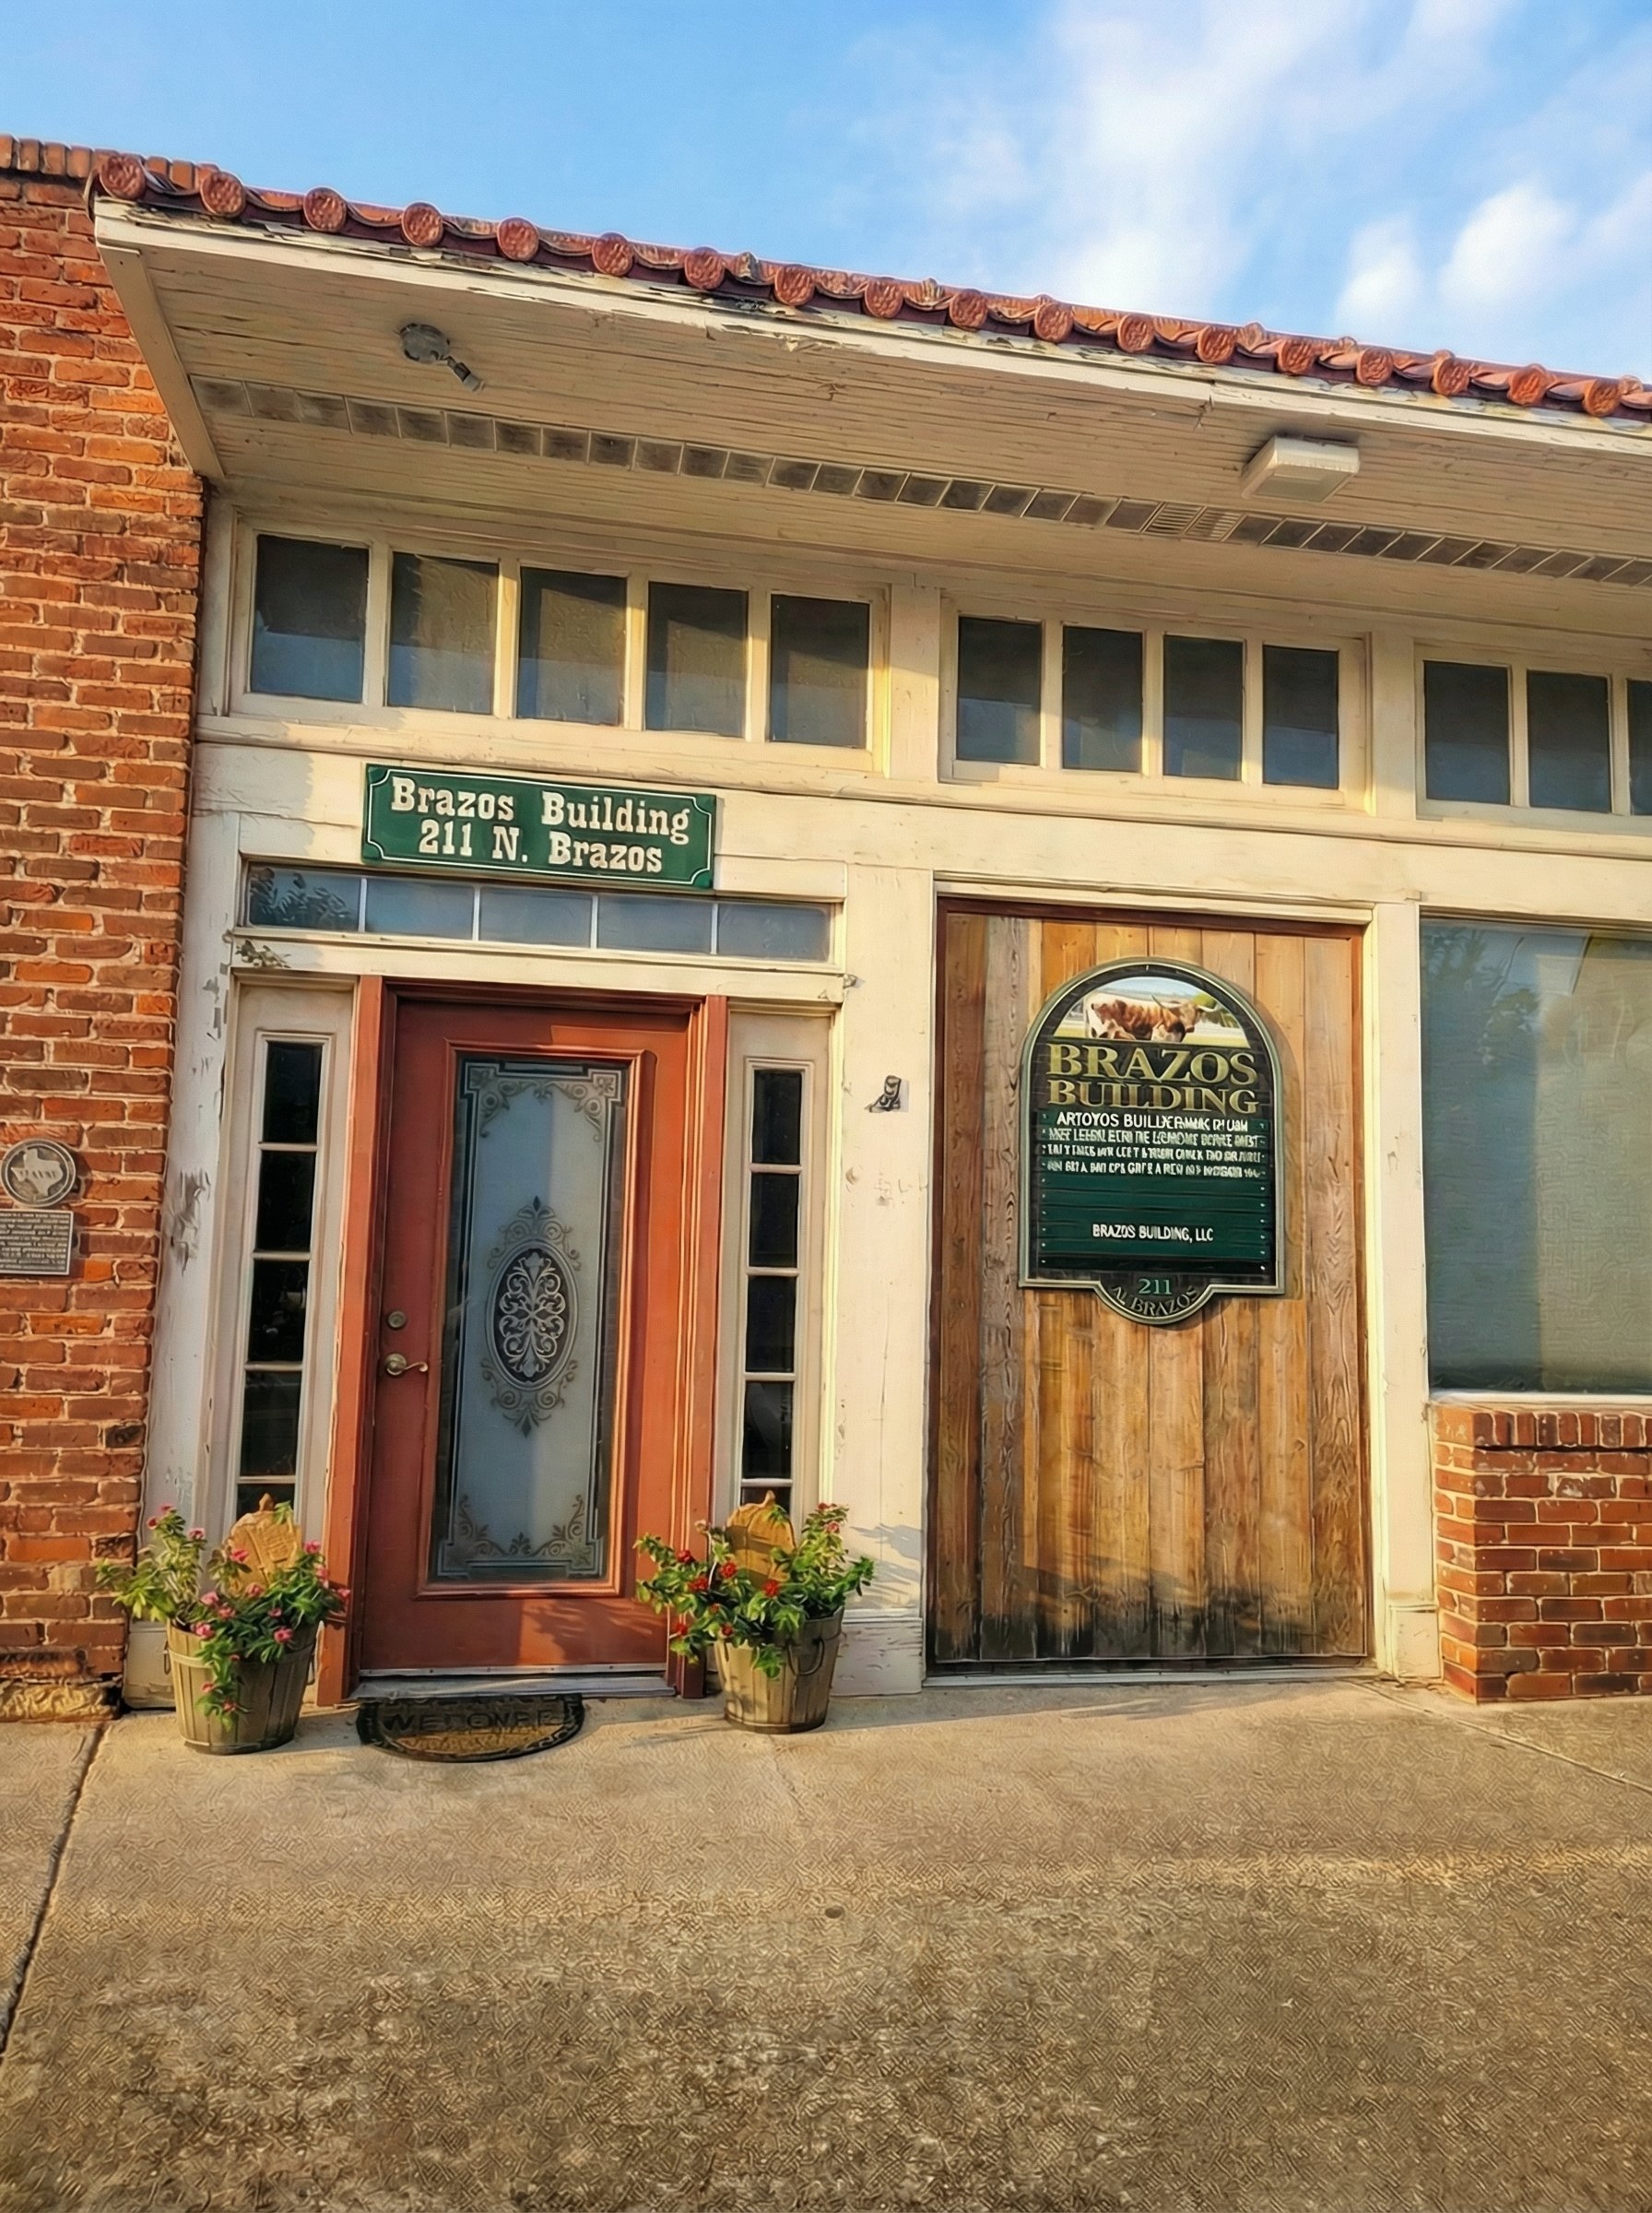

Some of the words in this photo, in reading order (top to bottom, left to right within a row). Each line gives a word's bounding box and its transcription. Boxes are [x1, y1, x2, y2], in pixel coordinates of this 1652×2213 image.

[391, 776, 514, 821] Brazos
[540, 790, 690, 846] Building
[419, 820, 472, 857] 211
[492, 826, 528, 863] N.
[549, 831, 663, 872] Brazos
[1045, 1043, 1258, 1086] BRAZOS
[1047, 1079, 1259, 1117] BUILDING
[1092, 1224, 1136, 1238] BRAZOS
[1139, 1225, 1193, 1243] BUILDING,
[1195, 1227, 1214, 1242] LLC
[1130, 1284, 1198, 1317] BRAZOS
[1139, 1278, 1173, 1295] 211
